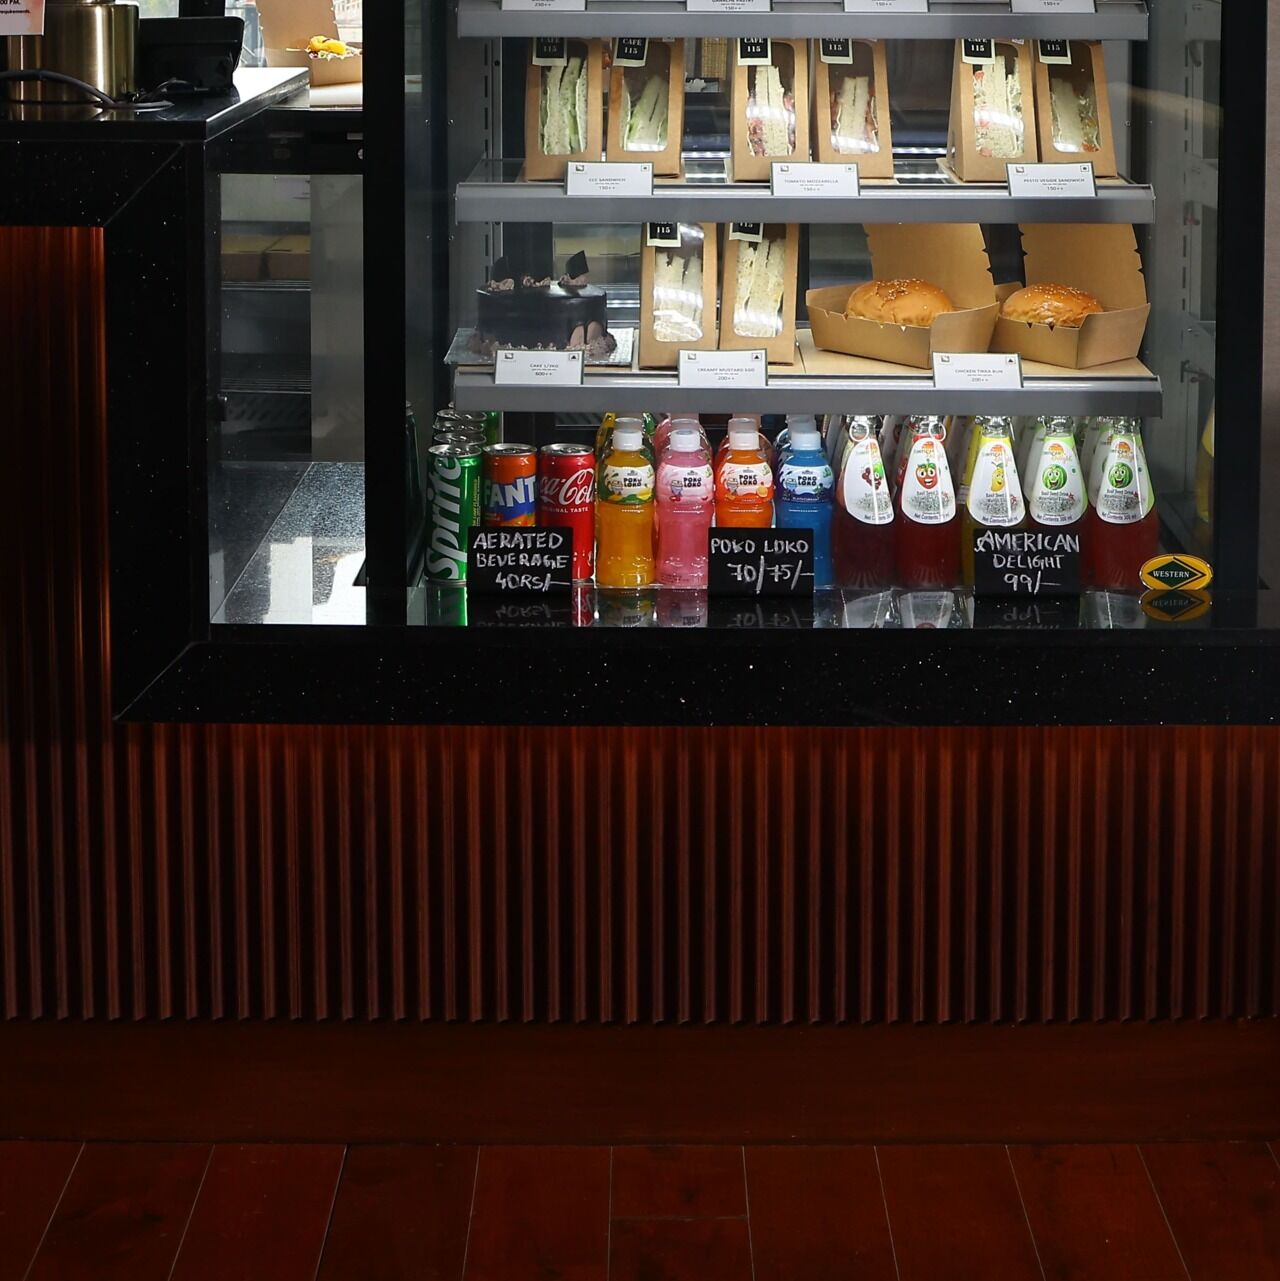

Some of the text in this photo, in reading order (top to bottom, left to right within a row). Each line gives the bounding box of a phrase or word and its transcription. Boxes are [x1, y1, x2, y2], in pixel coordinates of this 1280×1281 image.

[483, 476, 536, 507] FANT
[425, 457, 468, 579] Sprite
[473, 532, 564, 550] AERATED
[711, 538, 809, 554] POKO LOKO
[974, 530, 1080, 553] AMERICAN
[476, 552, 570, 569] BEVERAGE
[993, 553, 1065, 569] DELIGHT
[1152, 570, 1190, 578] WESTERN
